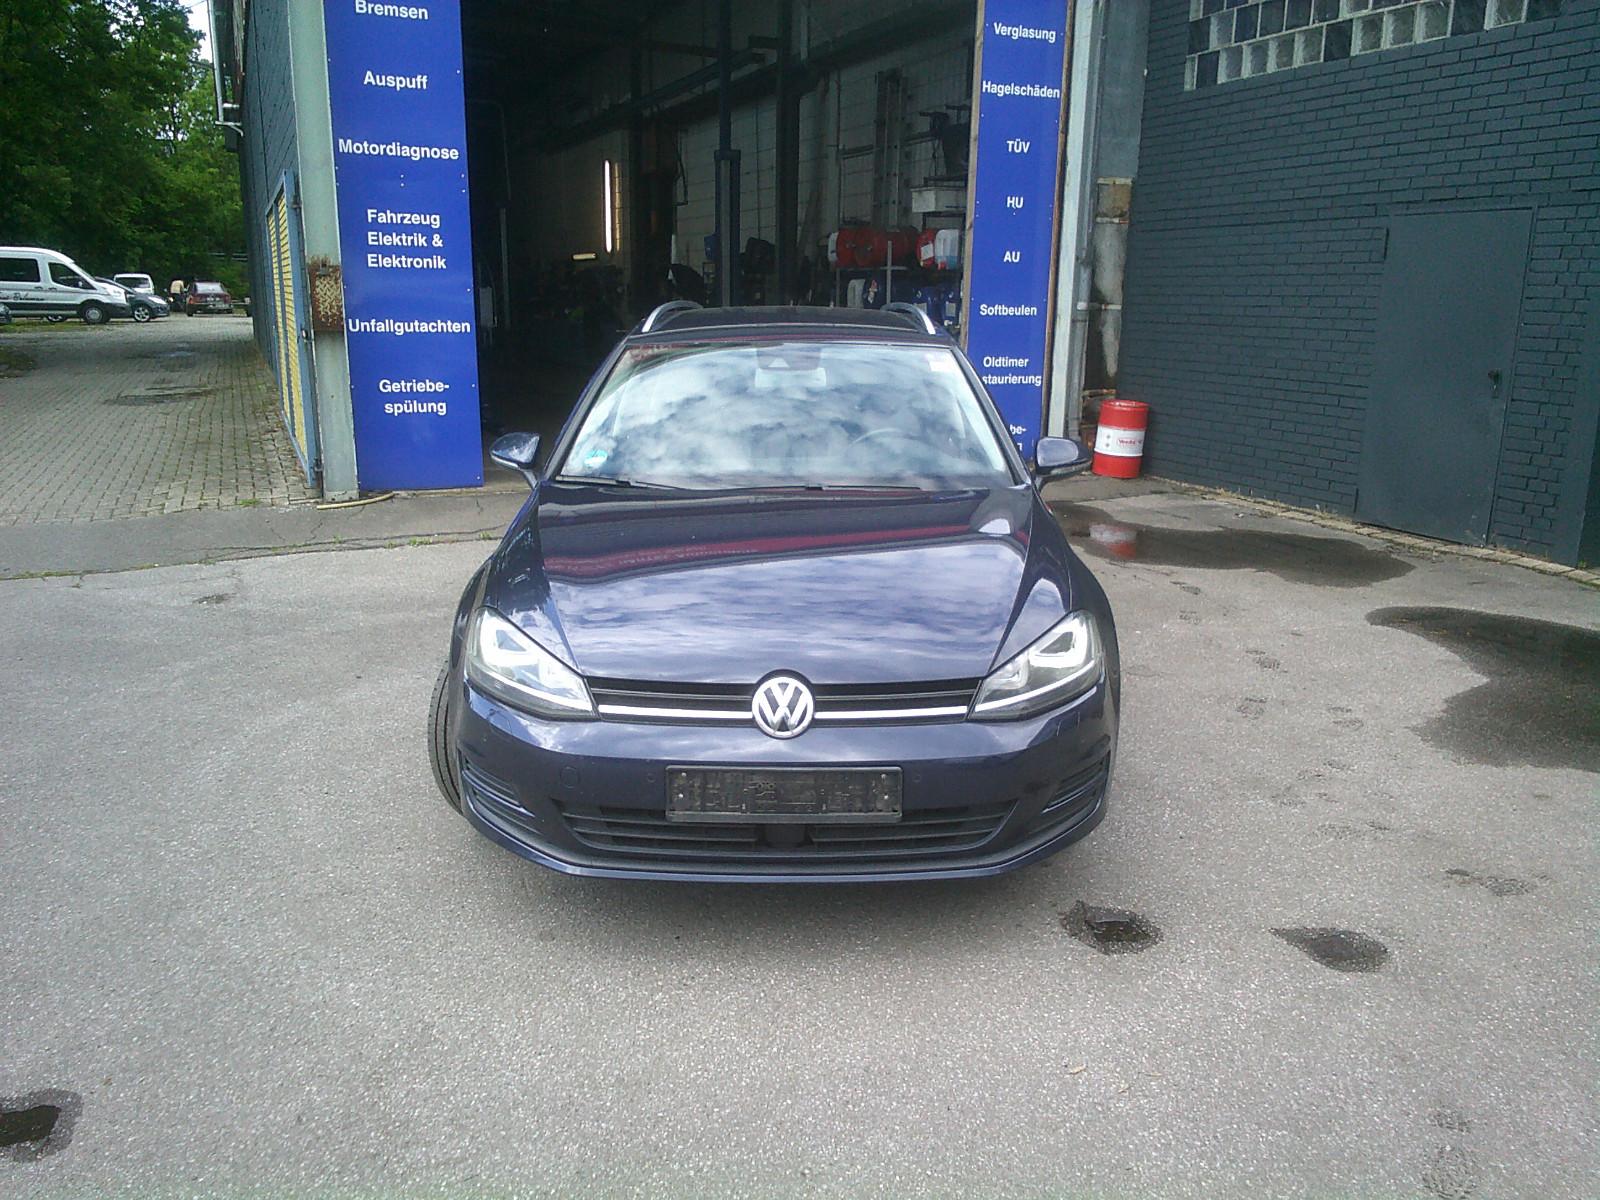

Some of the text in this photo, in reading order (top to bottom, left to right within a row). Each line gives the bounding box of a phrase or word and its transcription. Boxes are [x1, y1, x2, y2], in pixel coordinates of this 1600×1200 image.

[355, 0, 429, 20] Bremsen
[993, 21, 1057, 44] Verglasung
[363, 70, 428, 91] Auspuff
[982, 80, 1061, 99] Hagelschäden
[338, 138, 459, 161] Motordiagnose
[1006, 138, 1031, 154] TÜV
[1006, 196, 1024, 209] HU
[367, 208, 441, 229] Fahrzeug
[367, 231, 444, 248] Elektrik &
[367, 253, 447, 269] Elektronik
[1003, 250, 1021, 263] AU
[979, 303, 1038, 316] Softbeulen
[348, 318, 471, 336] Unfallgutachten
[982, 356, 1030, 368] Oldtimer
[378, 378, 450, 393] Getriebe-
[981, 373, 1042, 387] staurierung
[384, 399, 447, 416] spülung
